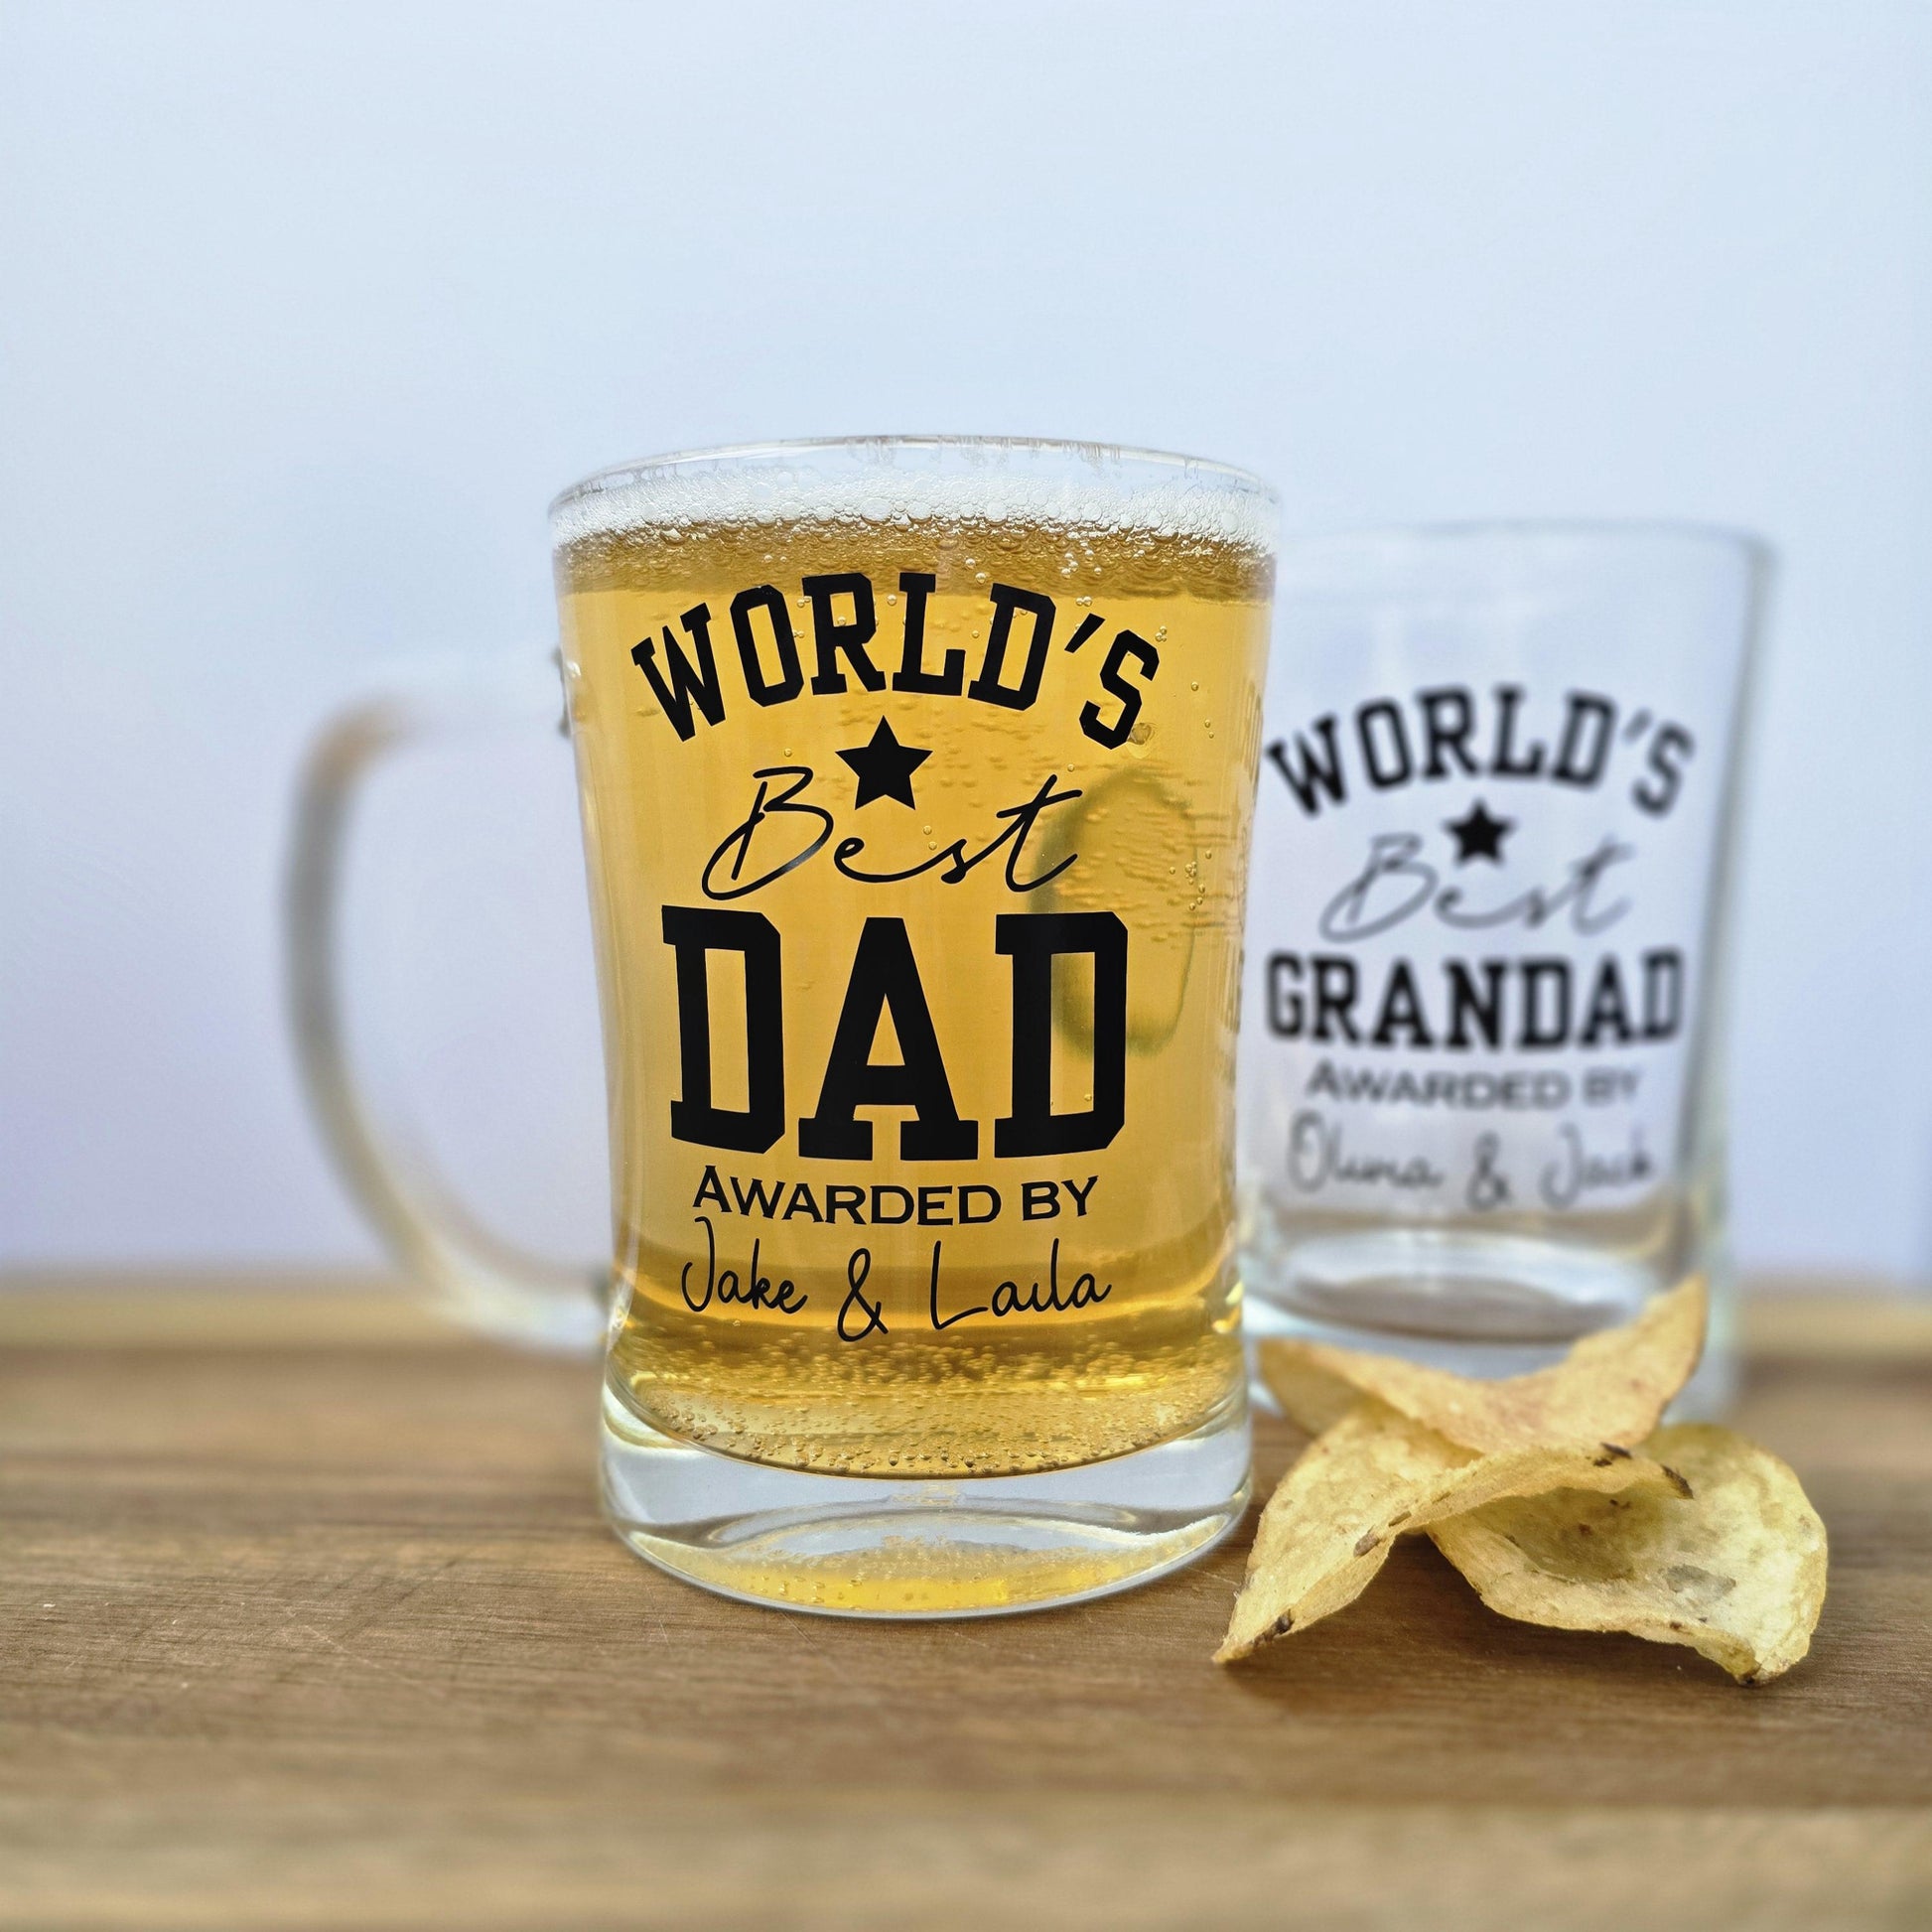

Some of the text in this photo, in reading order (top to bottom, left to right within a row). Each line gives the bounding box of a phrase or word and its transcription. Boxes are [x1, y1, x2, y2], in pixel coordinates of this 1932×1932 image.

[630, 572, 1160, 750] WORLD'S
[1266, 684, 1697, 818] WORLD'S
[701, 765, 1083, 900] Best
[1317, 833, 1636, 943] Best
[661, 904, 1129, 1162] DAD
[1264, 946, 1684, 1052] GRANDAD
[1582, 1065, 1643, 1107] BY
[692, 1165, 1099, 1225] AWARDED BY
[1465, 1130, 1511, 1212] &
[681, 1215, 1113, 1342] Jake & Laila
